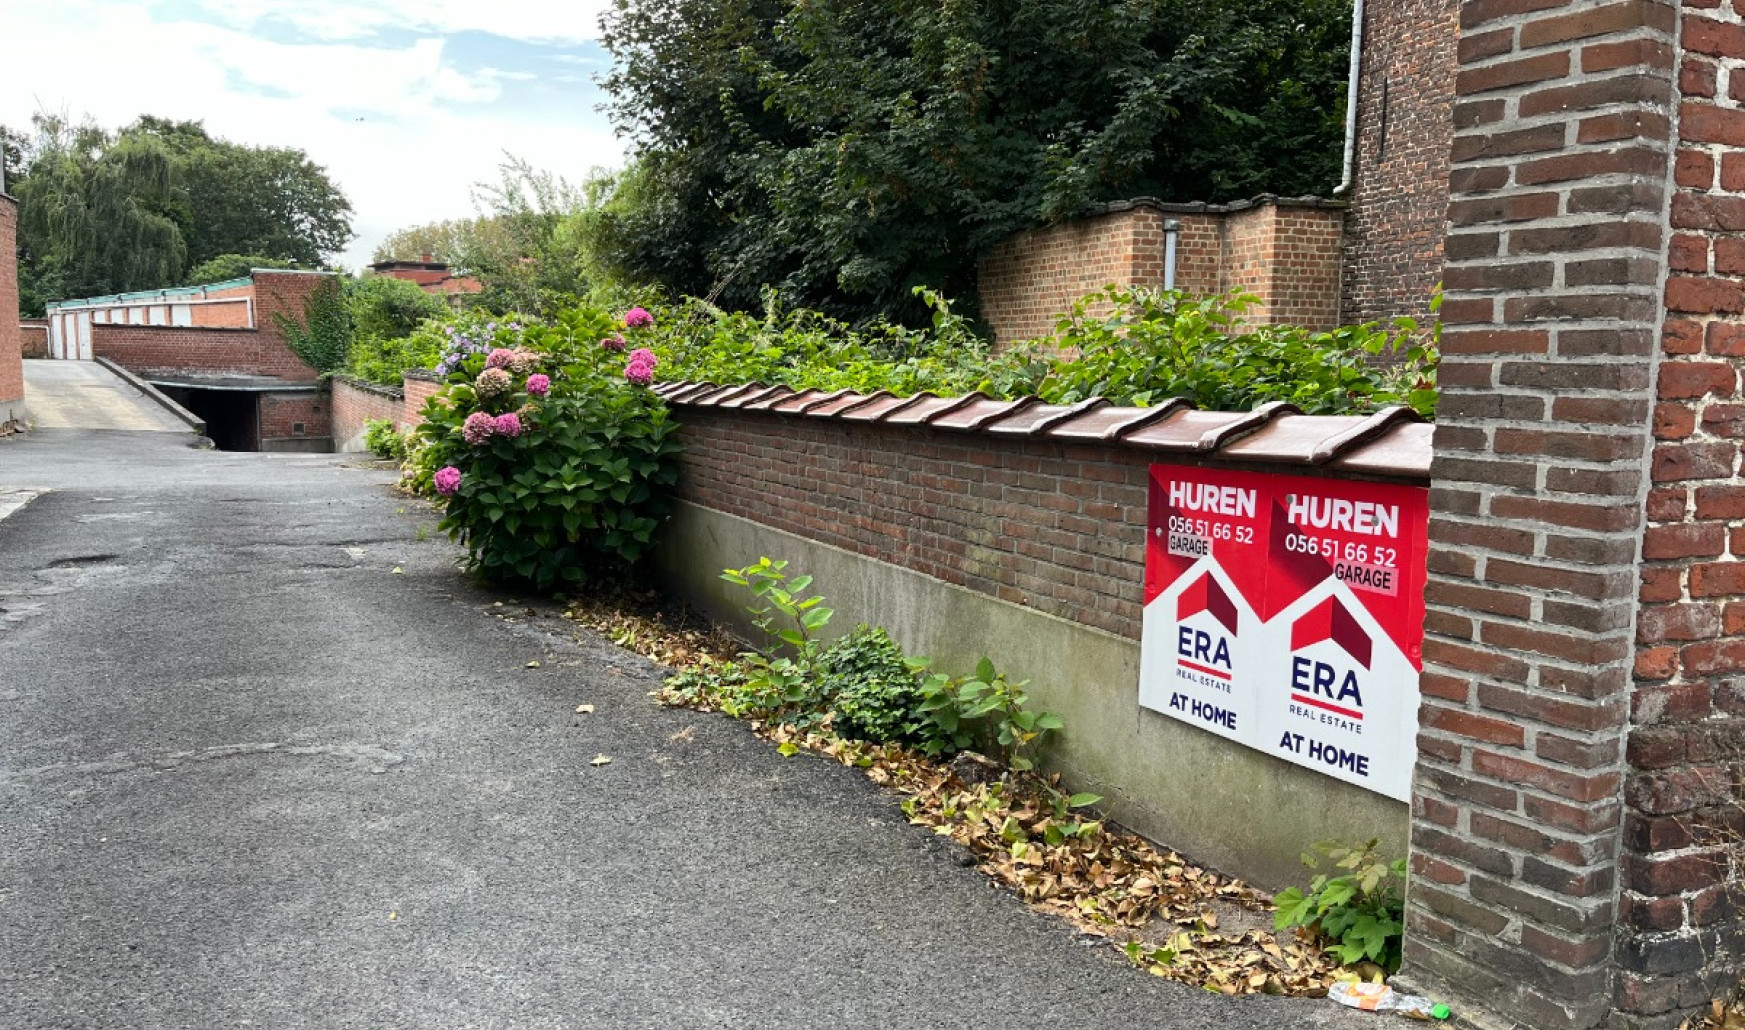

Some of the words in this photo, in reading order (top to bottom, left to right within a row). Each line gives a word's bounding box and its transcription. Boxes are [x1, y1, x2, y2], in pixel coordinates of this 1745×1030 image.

[1168, 480, 1257, 518] HUREN
[1288, 494, 1399, 538] HUREN
[1168, 516, 1192, 534] 056
[1195, 521, 1209, 536] 51
[1213, 522, 1230, 540] 66
[1236, 525, 1253, 544] 52
[1170, 536, 1208, 556] GARAGE
[1285, 534, 1318, 555] 056
[1322, 540, 1338, 558] 51
[1344, 543, 1368, 562] 66
[1374, 548, 1396, 568] 52
[1335, 563, 1391, 590] GARAGE
[1178, 626, 1232, 670] ERA
[1176, 668, 1197, 683] REAL
[1200, 676, 1232, 694] ESTATE
[1292, 656, 1363, 706] ERA
[1169, 692, 1188, 710] AT
[1192, 699, 1237, 730] HOME
[1290, 704, 1316, 721] REAL
[1320, 713, 1362, 734] ESTATE
[1280, 731, 1304, 752] AT
[1309, 739, 1369, 776] HOME
